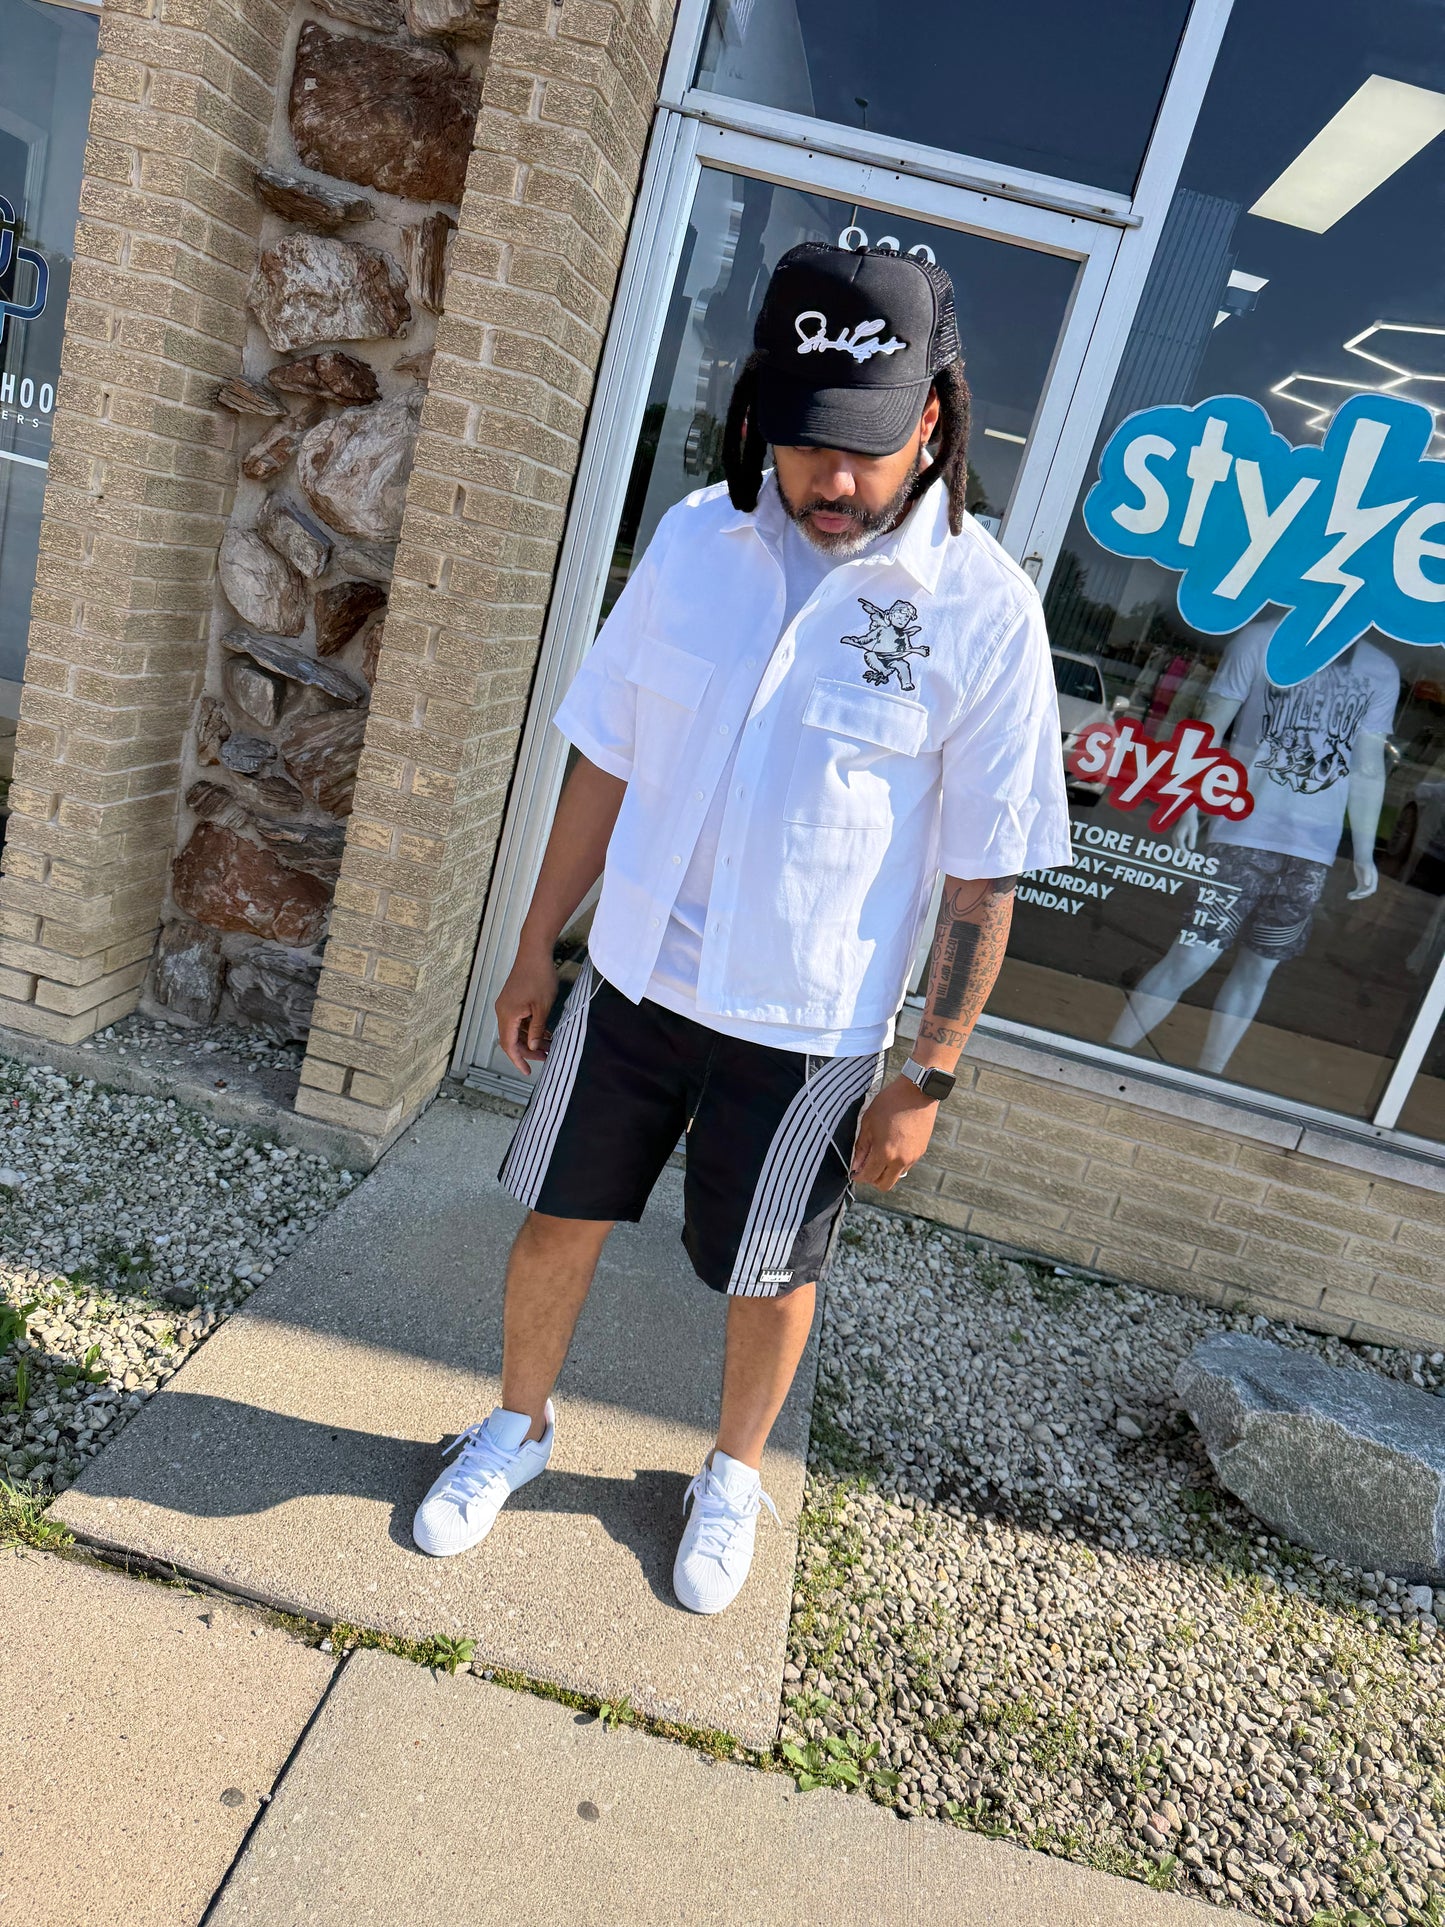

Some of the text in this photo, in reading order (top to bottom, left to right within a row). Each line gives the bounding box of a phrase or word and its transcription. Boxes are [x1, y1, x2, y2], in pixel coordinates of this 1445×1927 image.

[1069, 820, 1220, 876] TORE HOURS
[1017, 868, 1231, 931] ATURDAY 11-7
[1197, 886, 1239, 910] 12-7
[1178, 929, 1225, 953] 12-4
